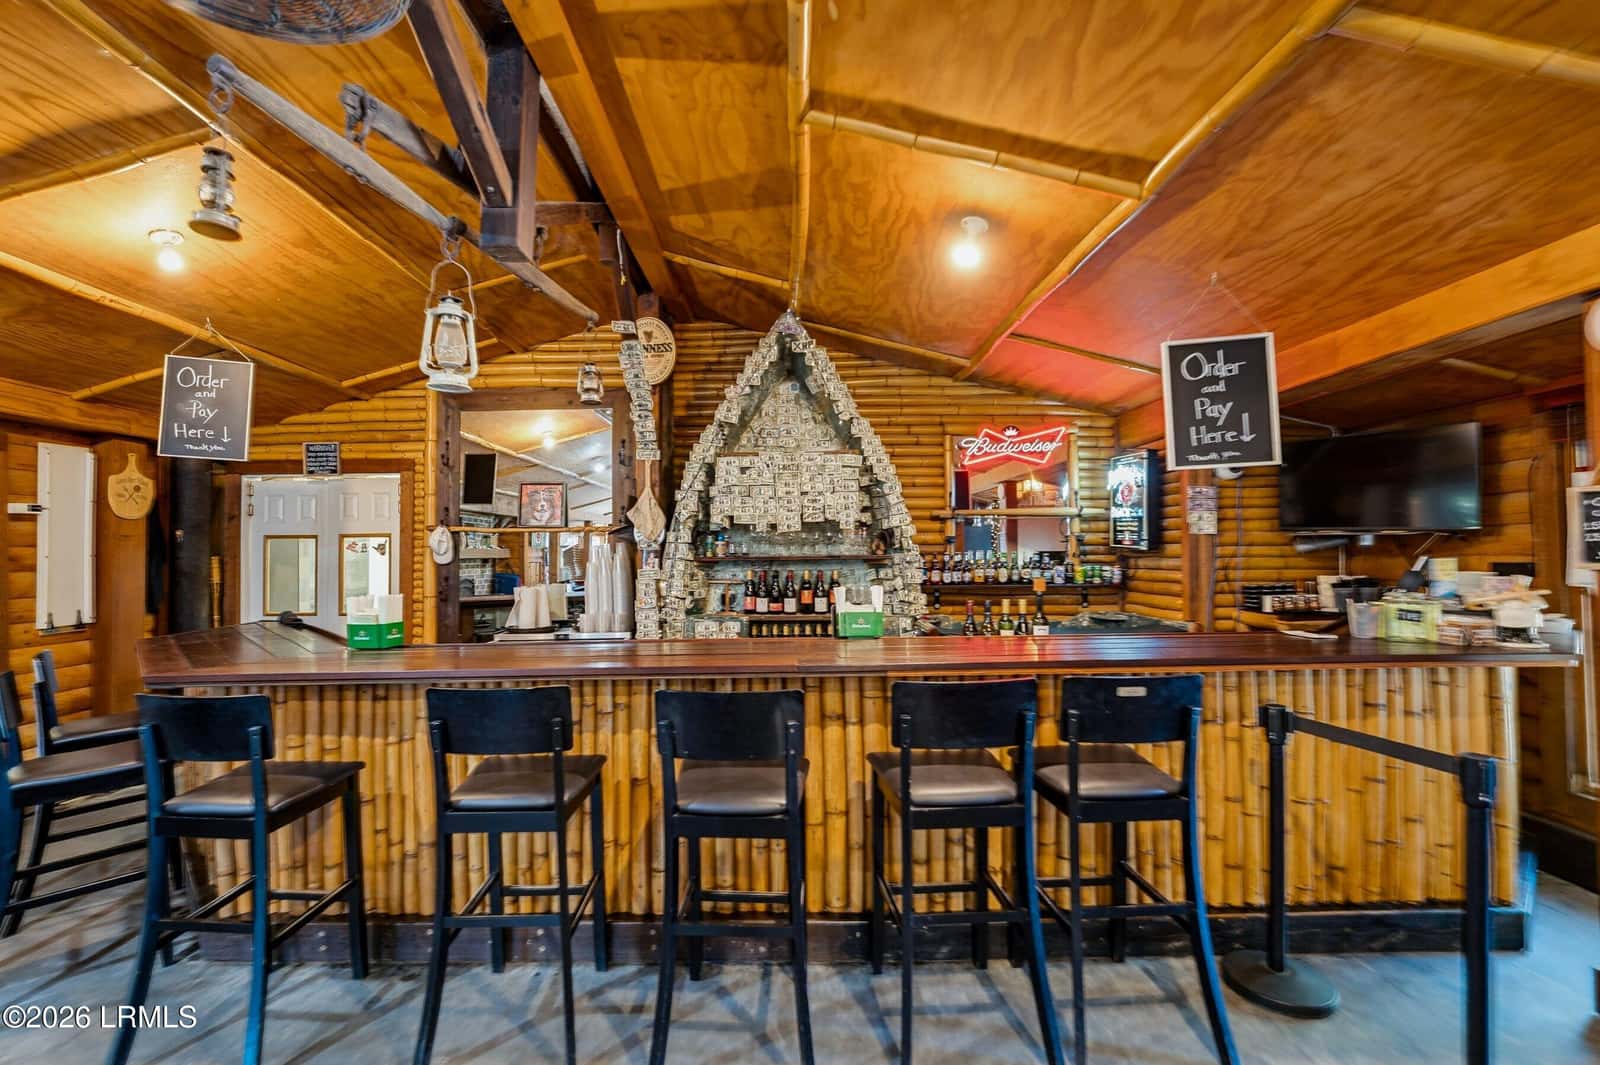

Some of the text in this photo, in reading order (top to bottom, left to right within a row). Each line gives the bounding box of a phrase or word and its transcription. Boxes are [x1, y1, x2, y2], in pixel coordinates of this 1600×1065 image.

[1180, 349, 1247, 380] Order
[177, 364, 230, 389] Order
[1200, 379, 1226, 394] and
[194, 388, 217, 399] and
[185, 400, 218, 424] Pay
[1193, 397, 1234, 427] Pay
[174, 422, 216, 440] Here
[1189, 424, 1240, 447] Here
[960, 436, 1063, 456] Budweiser
